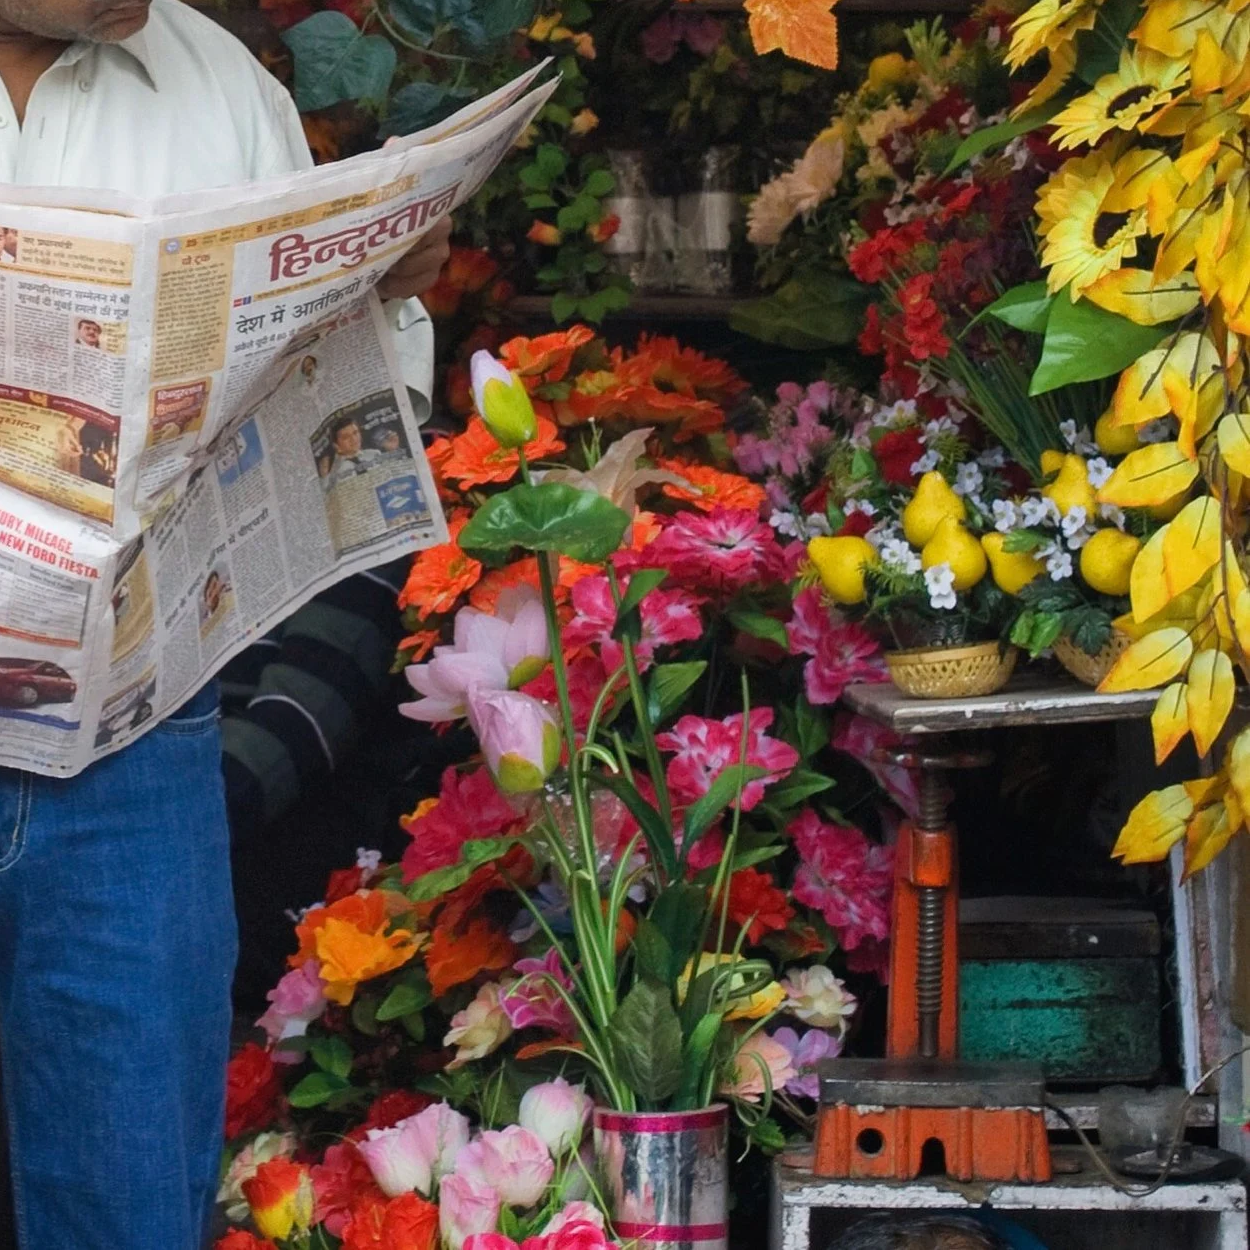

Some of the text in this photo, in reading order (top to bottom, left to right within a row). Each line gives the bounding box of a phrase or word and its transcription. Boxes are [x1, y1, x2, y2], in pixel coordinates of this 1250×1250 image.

[269, 180, 463, 282] हिन्दुस्तान
[235, 313, 266, 334] देश
[270, 303, 286, 324] में
[292, 275, 365, 318] आतंकियों
[0, 529, 26, 554] NEW
[26, 541, 57, 567] FORD
